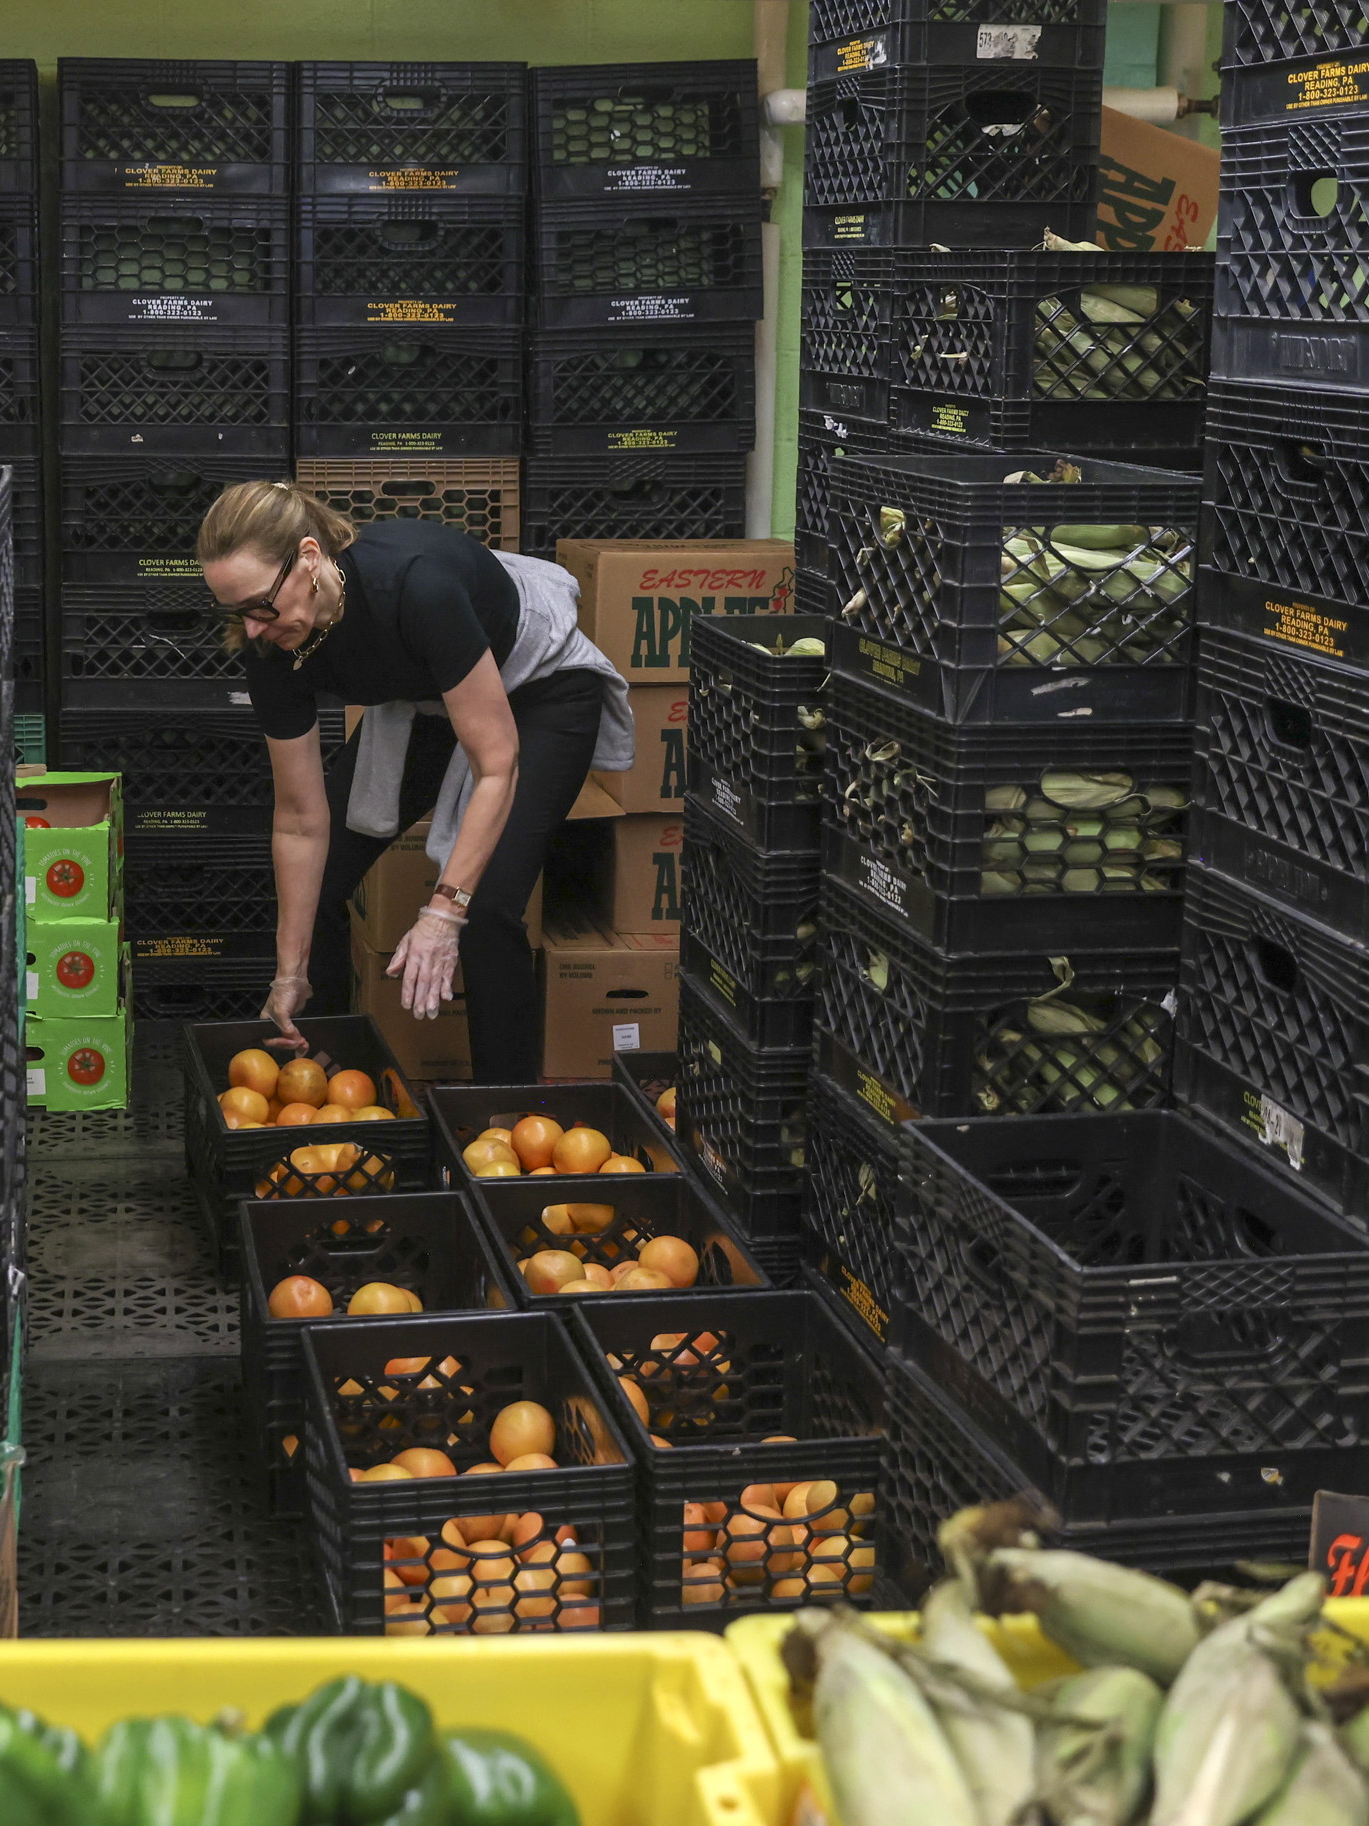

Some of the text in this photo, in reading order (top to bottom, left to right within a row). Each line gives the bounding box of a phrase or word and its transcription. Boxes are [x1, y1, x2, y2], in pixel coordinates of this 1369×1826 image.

[1288, 62, 1369, 84] CLOVER FARMS DAIRY
[1305, 76, 1353, 90] READING, PA
[1298, 85, 1358, 100] 1-800-323-0123
[639, 569, 766, 590] EASTERN
[1265, 601, 1348, 631] CLOVER FARMS DAIRY
[1281, 615, 1329, 636] READING, PA
[1275, 622, 1334, 646] 1-800-323-0123
